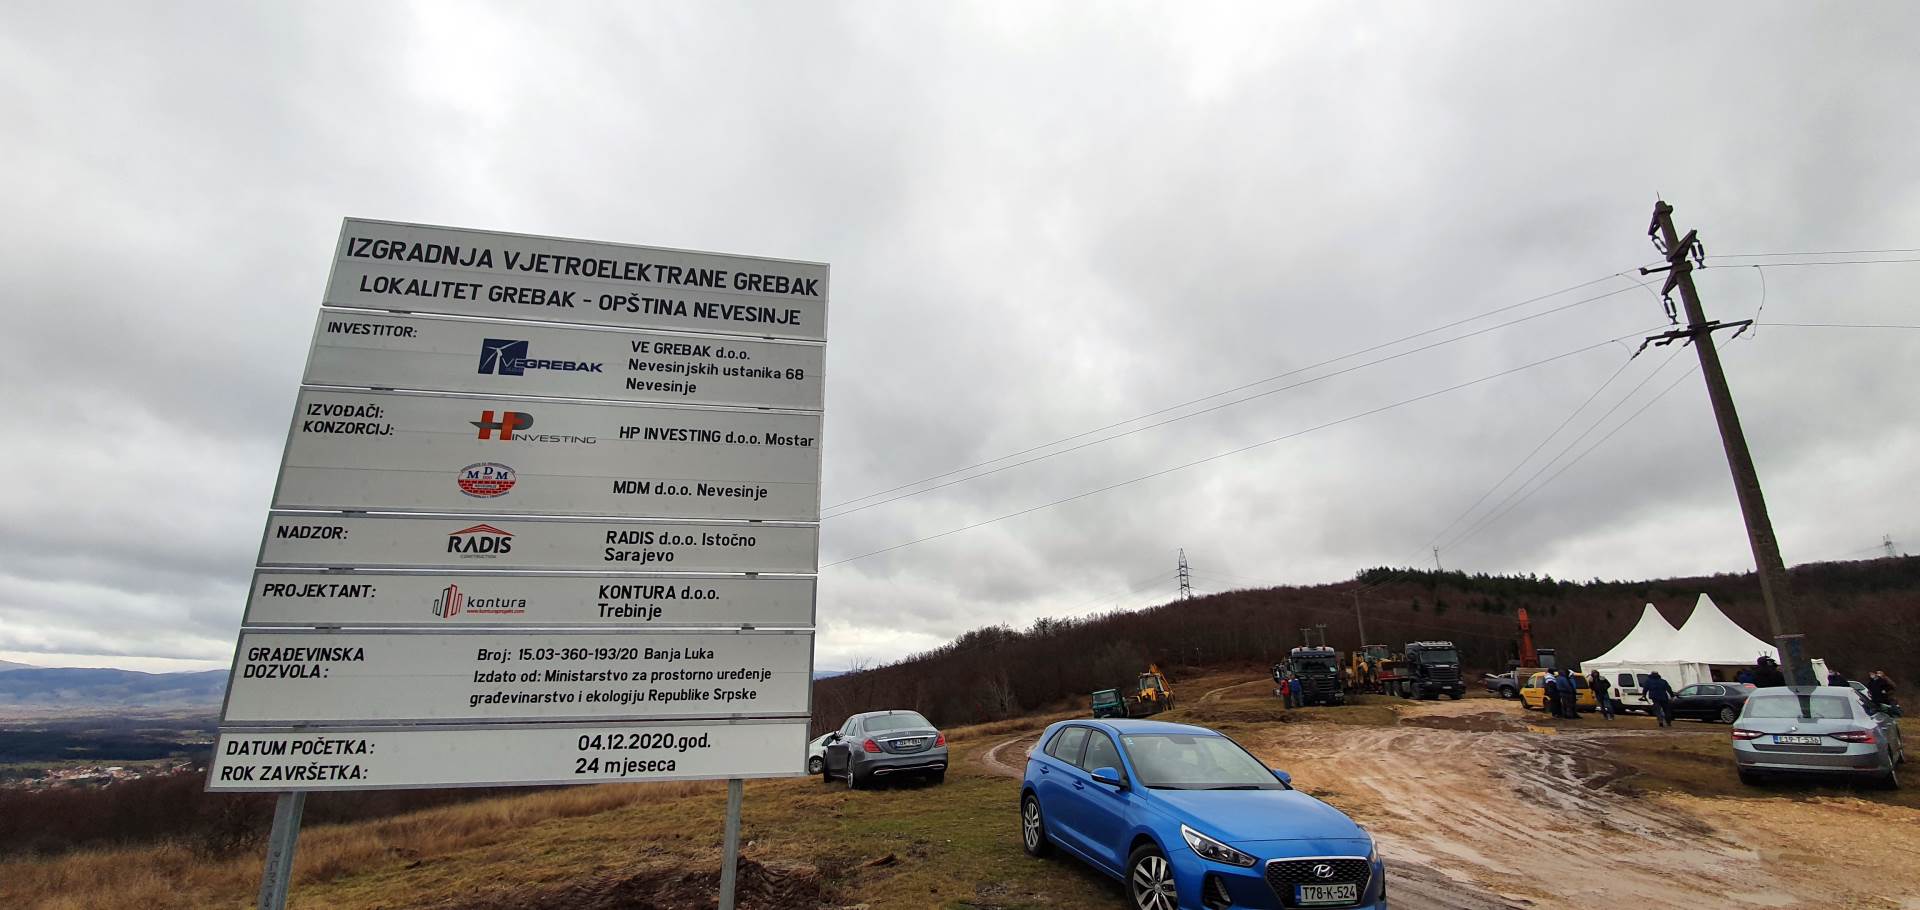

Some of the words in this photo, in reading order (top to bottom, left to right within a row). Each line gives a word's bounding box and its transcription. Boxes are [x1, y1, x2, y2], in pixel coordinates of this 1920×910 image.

[347, 237, 493, 268] IZGRADNJA
[504, 251, 728, 289] VJETROELEKTRANE
[734, 272, 818, 296] GREBAK
[360, 275, 481, 300] LOKALITET
[488, 286, 575, 308] GREBAK
[599, 293, 687, 316] OPŠTINA
[694, 302, 801, 325] NEVESINJE
[328, 322, 417, 337] INVESTITOR:
[632, 341, 650, 353] VE
[654, 342, 711, 357] GREBAK
[716, 347, 750, 360] d.o.o.
[628, 358, 718, 376] Nevesinjskih
[723, 366, 781, 379] ustanika
[786, 368, 804, 380] 68
[626, 377, 696, 395] Nevesinje
[307, 403, 384, 418] IZVOĐAČI:
[303, 420, 394, 435] KONZORCIJ:
[620, 426, 640, 439] HP
[644, 427, 721, 442] INVESTING
[726, 431, 760, 444] d.o.o.
[765, 433, 814, 446] Mostar
[512, 434, 597, 444] INVESTING
[613, 481, 650, 494] MDM
[655, 482, 692, 496] d.o.o.
[697, 483, 767, 501] Nevesinje
[277, 526, 348, 539] NADZOR:
[606, 531, 654, 545] RADIS
[659, 532, 697, 545] d.o.o.
[702, 533, 756, 547] Istočno
[447, 536, 512, 553] RADIS
[604, 547, 674, 565] Sarajevo
[263, 584, 376, 598] PROJEKTANT:
[599, 585, 676, 599] KONTURA
[681, 586, 719, 600] d.o.o.
[467, 596, 526, 608] kontura
[598, 603, 662, 621] Trebinje
[248, 647, 364, 661] GRAĐEVINSKA
[477, 649, 511, 664] Broj:
[519, 648, 638, 660] 15.03-360-193/20
[644, 648, 680, 662] Banja
[685, 648, 714, 659] Luka
[474, 670, 516, 682] Izdato
[520, 670, 542, 683] od:
[544, 670, 628, 682] Ministarstvo
[632, 672, 647, 681] za
[651, 669, 713, 684] prostorno
[717, 668, 771, 682] uređenje
[470, 691, 574, 707] građevinarstvo
[578, 690, 582, 702] i
[586, 690, 644, 705] ekologiju
[648, 689, 709, 704] Republike
[713, 688, 756, 703] Srpske
[226, 741, 287, 755] DATUM
[291, 737, 375, 755] POČETKA:
[578, 732, 710, 752] 04.12.2020.god.
[221, 766, 256, 781] ROK
[259, 762, 368, 781] ZAVRŠETKA:
[575, 757, 599, 774] 24
[605, 757, 675, 777] mjeseca
[1303, 886, 1356, 900] T78-K-524
